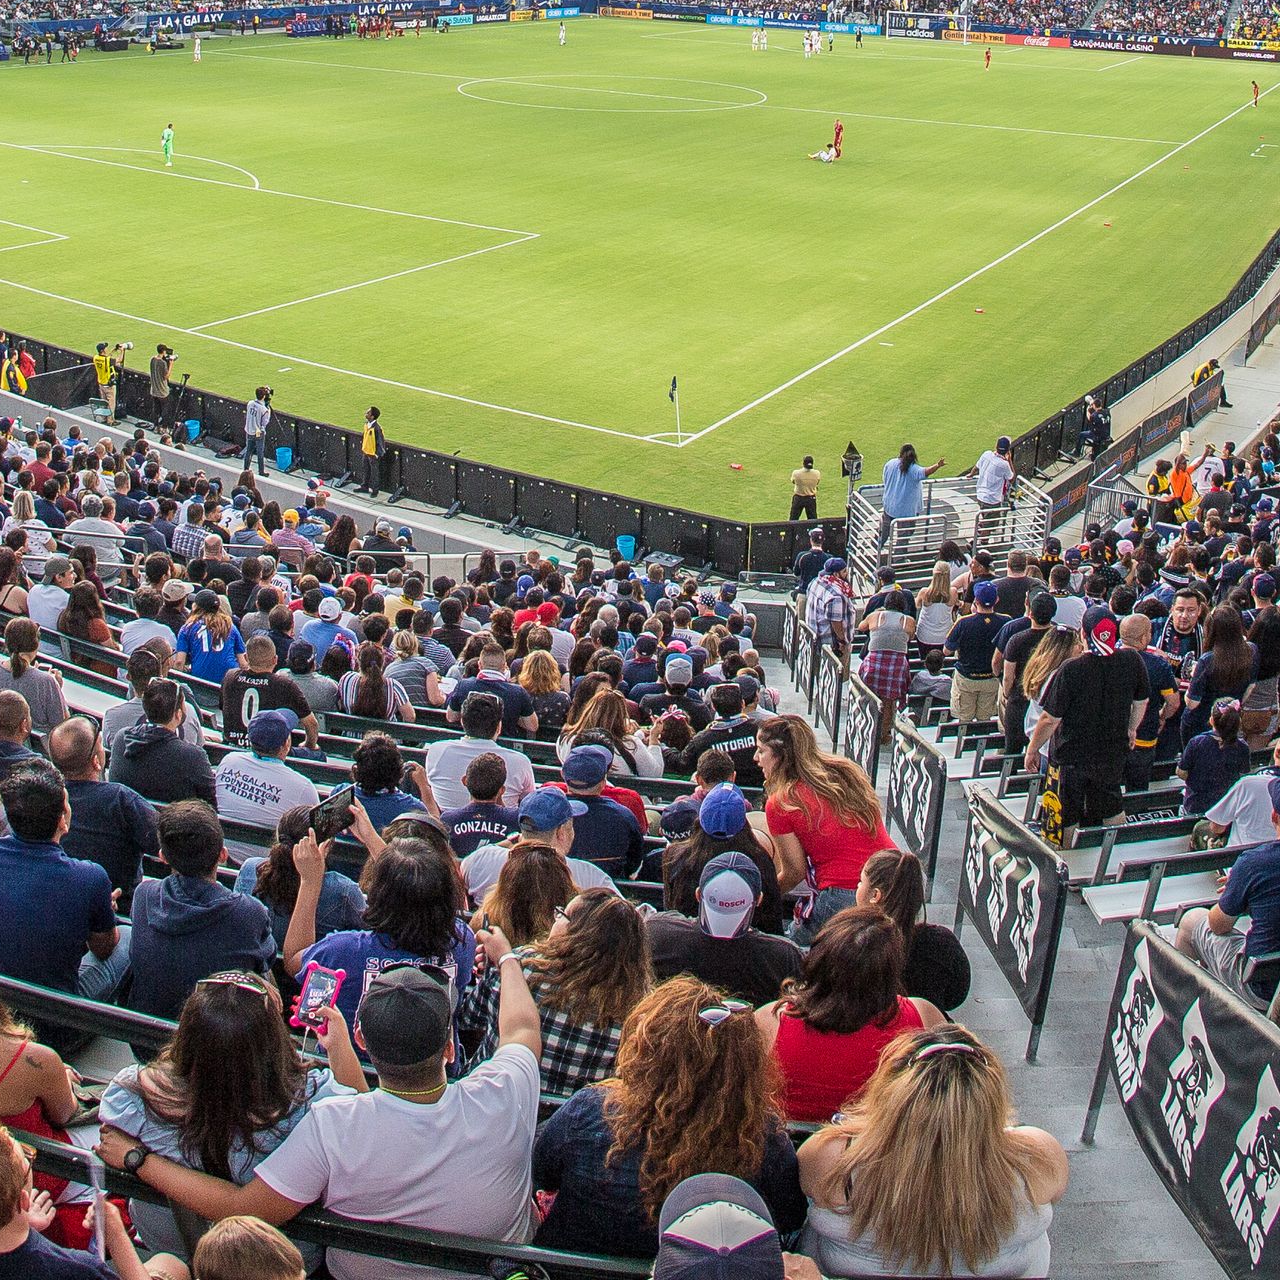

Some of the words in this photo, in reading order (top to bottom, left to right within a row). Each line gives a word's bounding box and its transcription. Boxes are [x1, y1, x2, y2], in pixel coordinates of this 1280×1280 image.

[358, 6, 374, 16] LA
[159, 17, 173, 28] LA
[183, 13, 224, 26] GALAXY
[907, 29, 935, 38] adidas
[1023, 36, 1052, 46] Coca-Cola
[1073, 40, 1089, 48] SAN
[1095, 41, 1125, 50] MANUEL
[1126, 44, 1154, 52] CASINO
[1204, 467, 1212, 482] 7
[237, 675, 269, 686] SALAZAR
[242, 687, 259, 728] 0
[223, 767, 233, 777] LA
[241, 773, 282, 795] GALAXY
[220, 773, 281, 805] FOUNDATION
[224, 783, 267, 806] FRIDAYS
[454, 821, 512, 838] GONZALEZ
[718, 899, 746, 908] BOSCH
[1160, 1077, 1191, 1179] LARS
[1219, 1151, 1263, 1267] LARS
